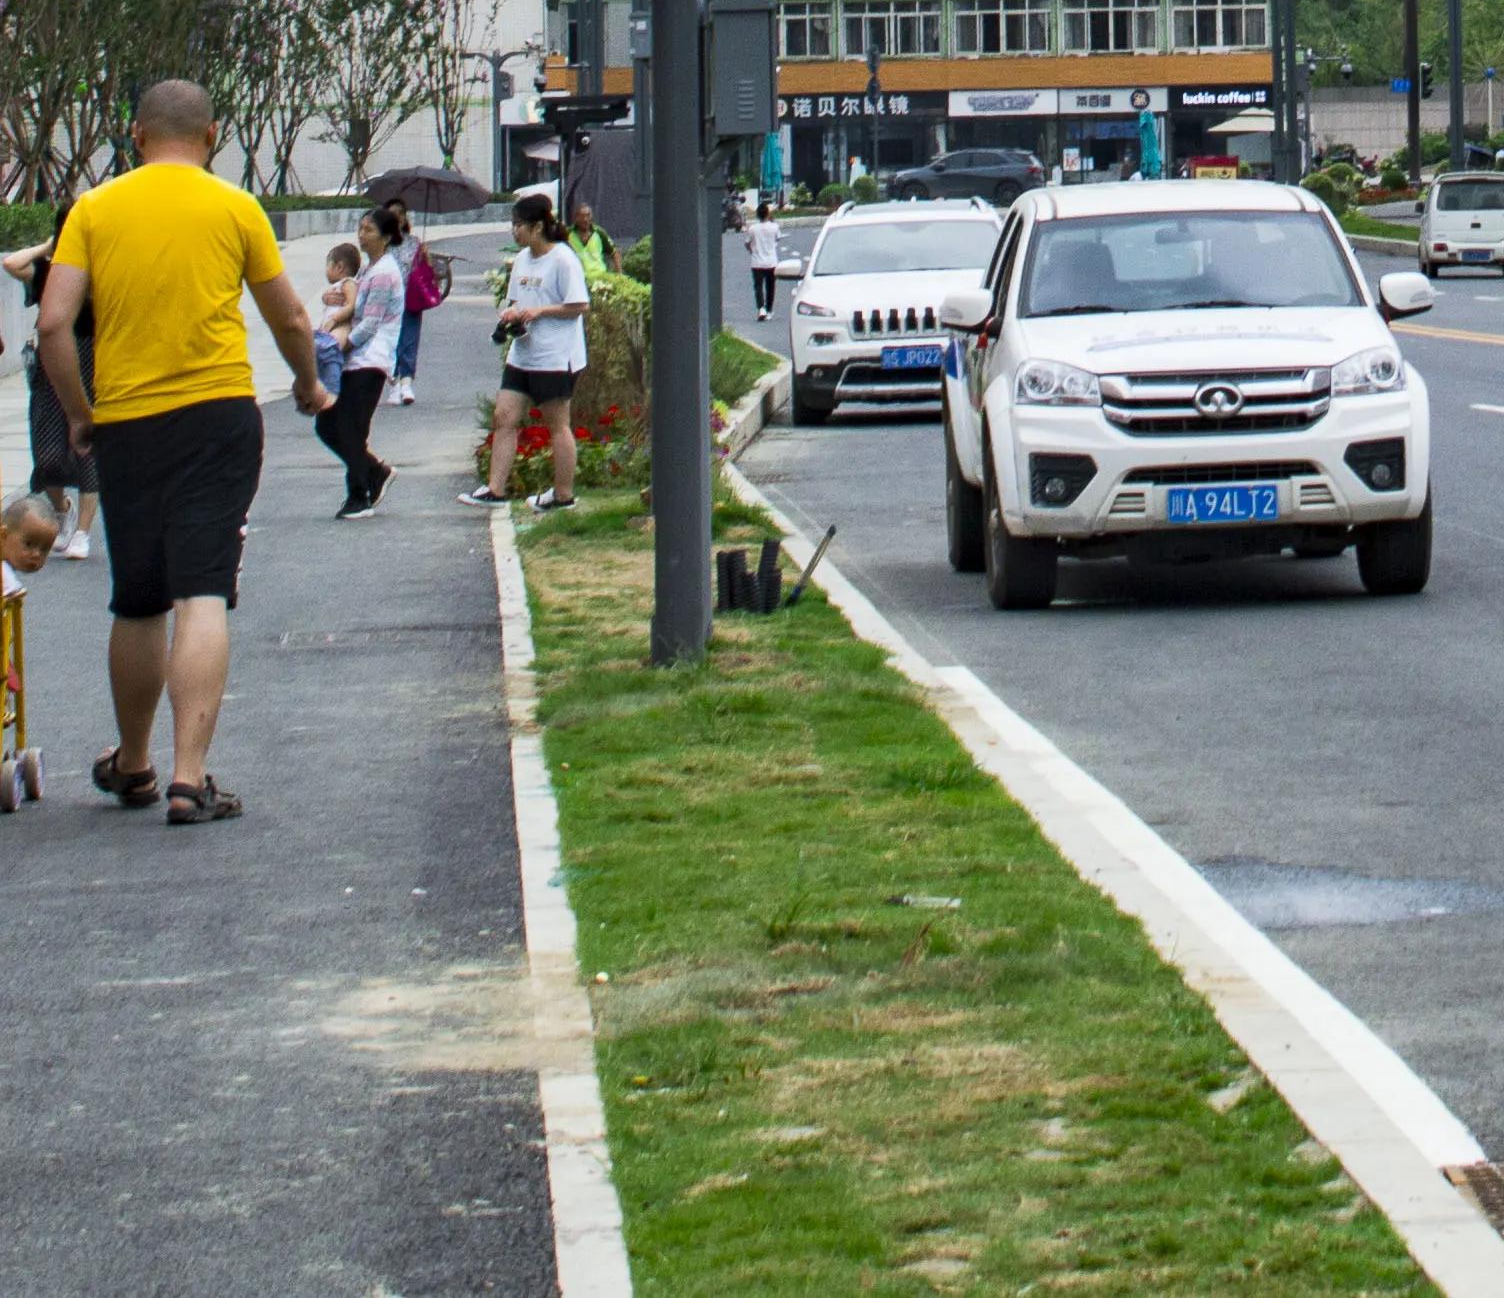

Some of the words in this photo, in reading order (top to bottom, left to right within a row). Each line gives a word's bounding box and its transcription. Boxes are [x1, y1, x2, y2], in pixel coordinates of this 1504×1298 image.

[792, 94, 910, 118] 诺贝尔眼镜
[1182, 91, 1215, 104] luckin
[1217, 90, 1251, 103] coffee
